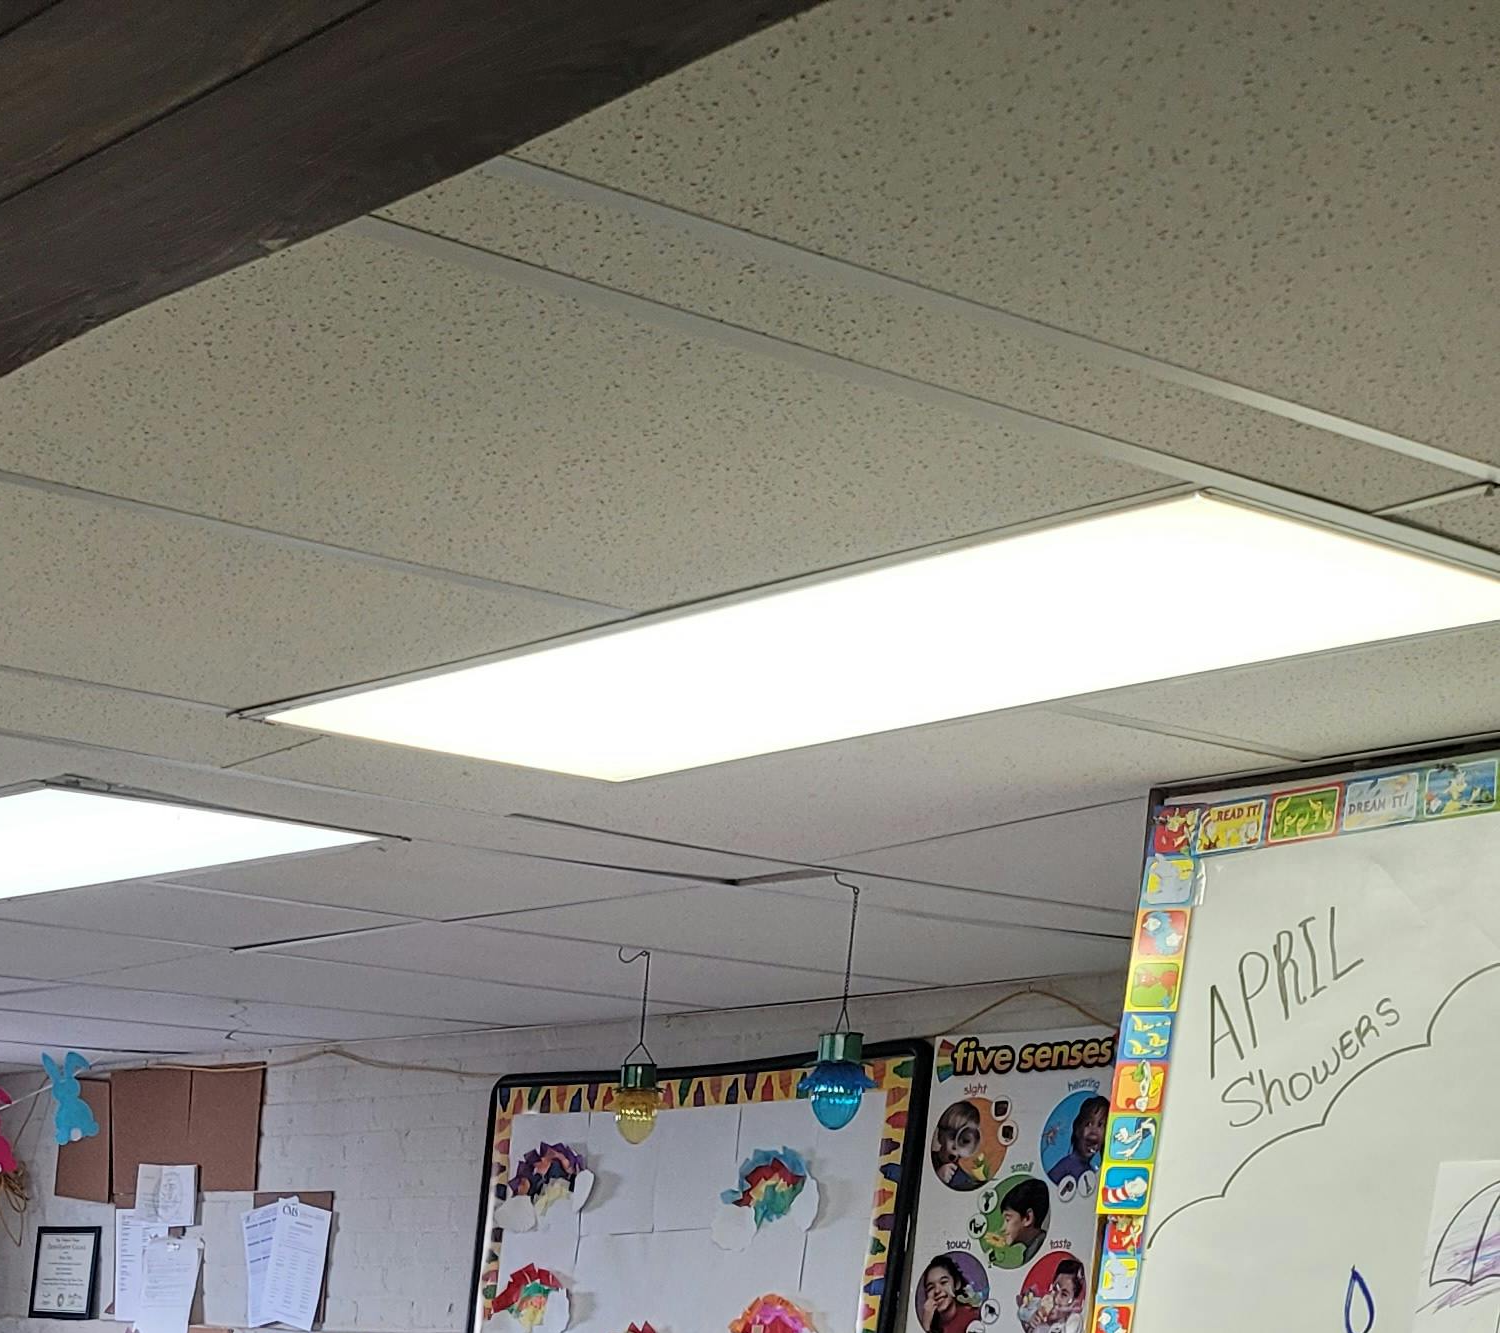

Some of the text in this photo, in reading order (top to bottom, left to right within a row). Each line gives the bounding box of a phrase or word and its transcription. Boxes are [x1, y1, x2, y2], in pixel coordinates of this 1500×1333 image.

[1215, 801, 1263, 822] READ IT!
[1348, 796, 1386, 815] DREAM
[1210, 906, 1365, 1079] APRIL
[953, 1038, 1113, 1073] five senses
[963, 1083, 988, 1097] sight
[1067, 1078, 1101, 1094] hearing
[1010, 1161, 1035, 1174] smell
[946, 1239, 972, 1251] touch
[1049, 1239, 1072, 1250] taste
